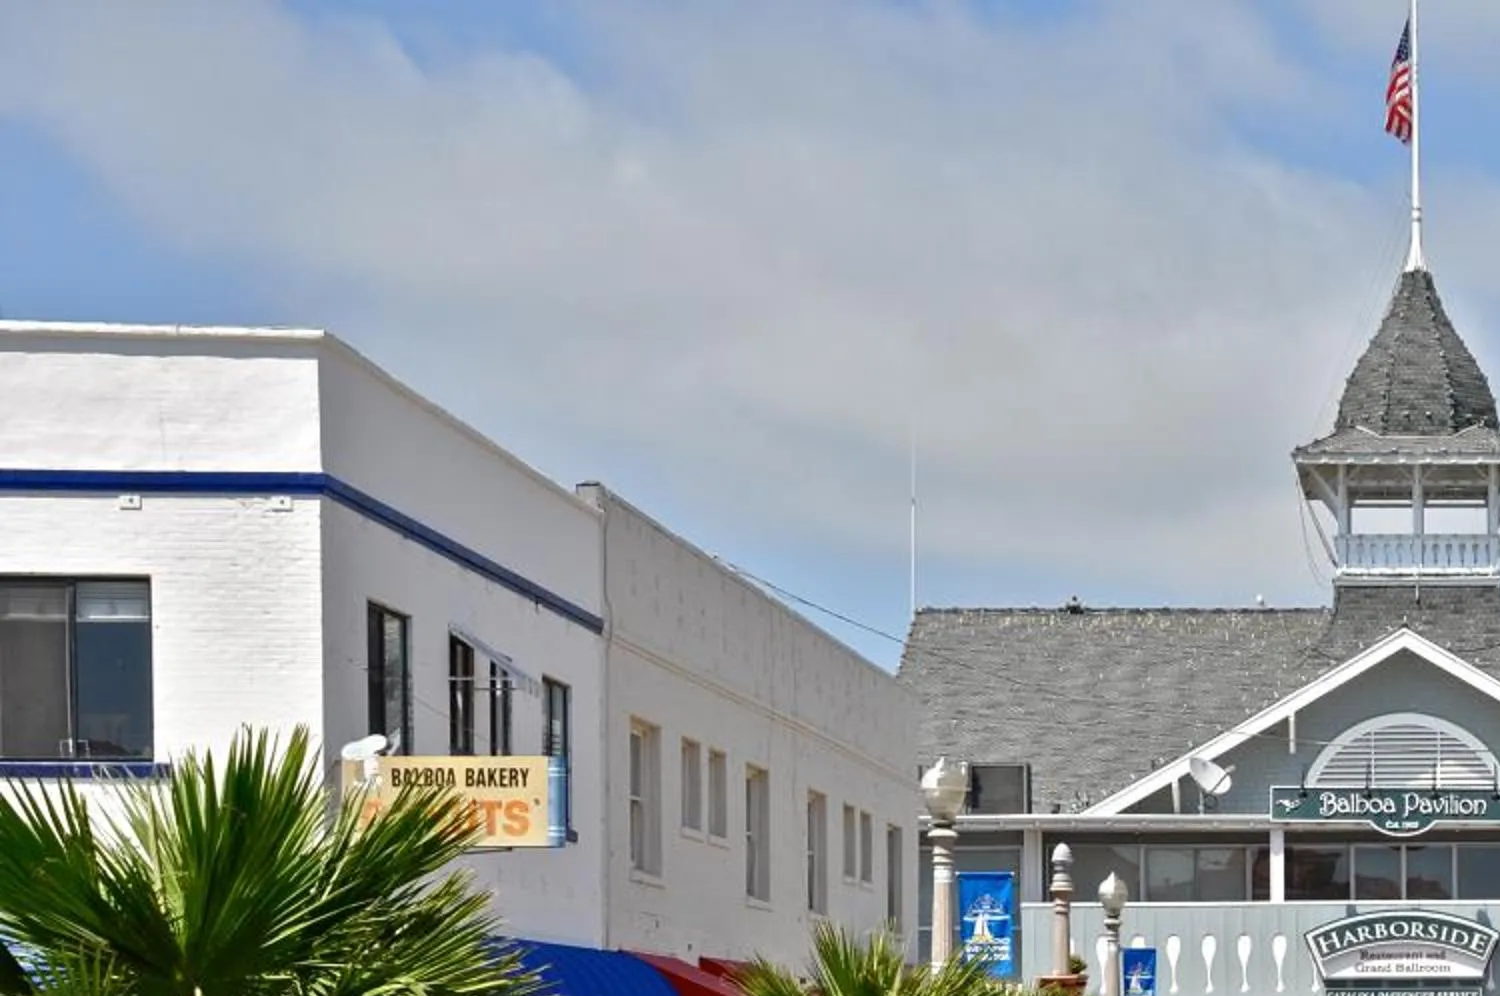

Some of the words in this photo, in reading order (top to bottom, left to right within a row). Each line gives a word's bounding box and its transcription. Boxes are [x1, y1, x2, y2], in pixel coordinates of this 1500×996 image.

[391, 767, 456, 788] BALBOA
[465, 767, 530, 788] BAKERY
[1319, 791, 1396, 816] Balboa
[1402, 792, 1487, 818] Pavilion
[1317, 920, 1488, 954] HARBORSIDE
[1355, 963, 1392, 973] Grand
[1395, 963, 1451, 973] Ballroom
